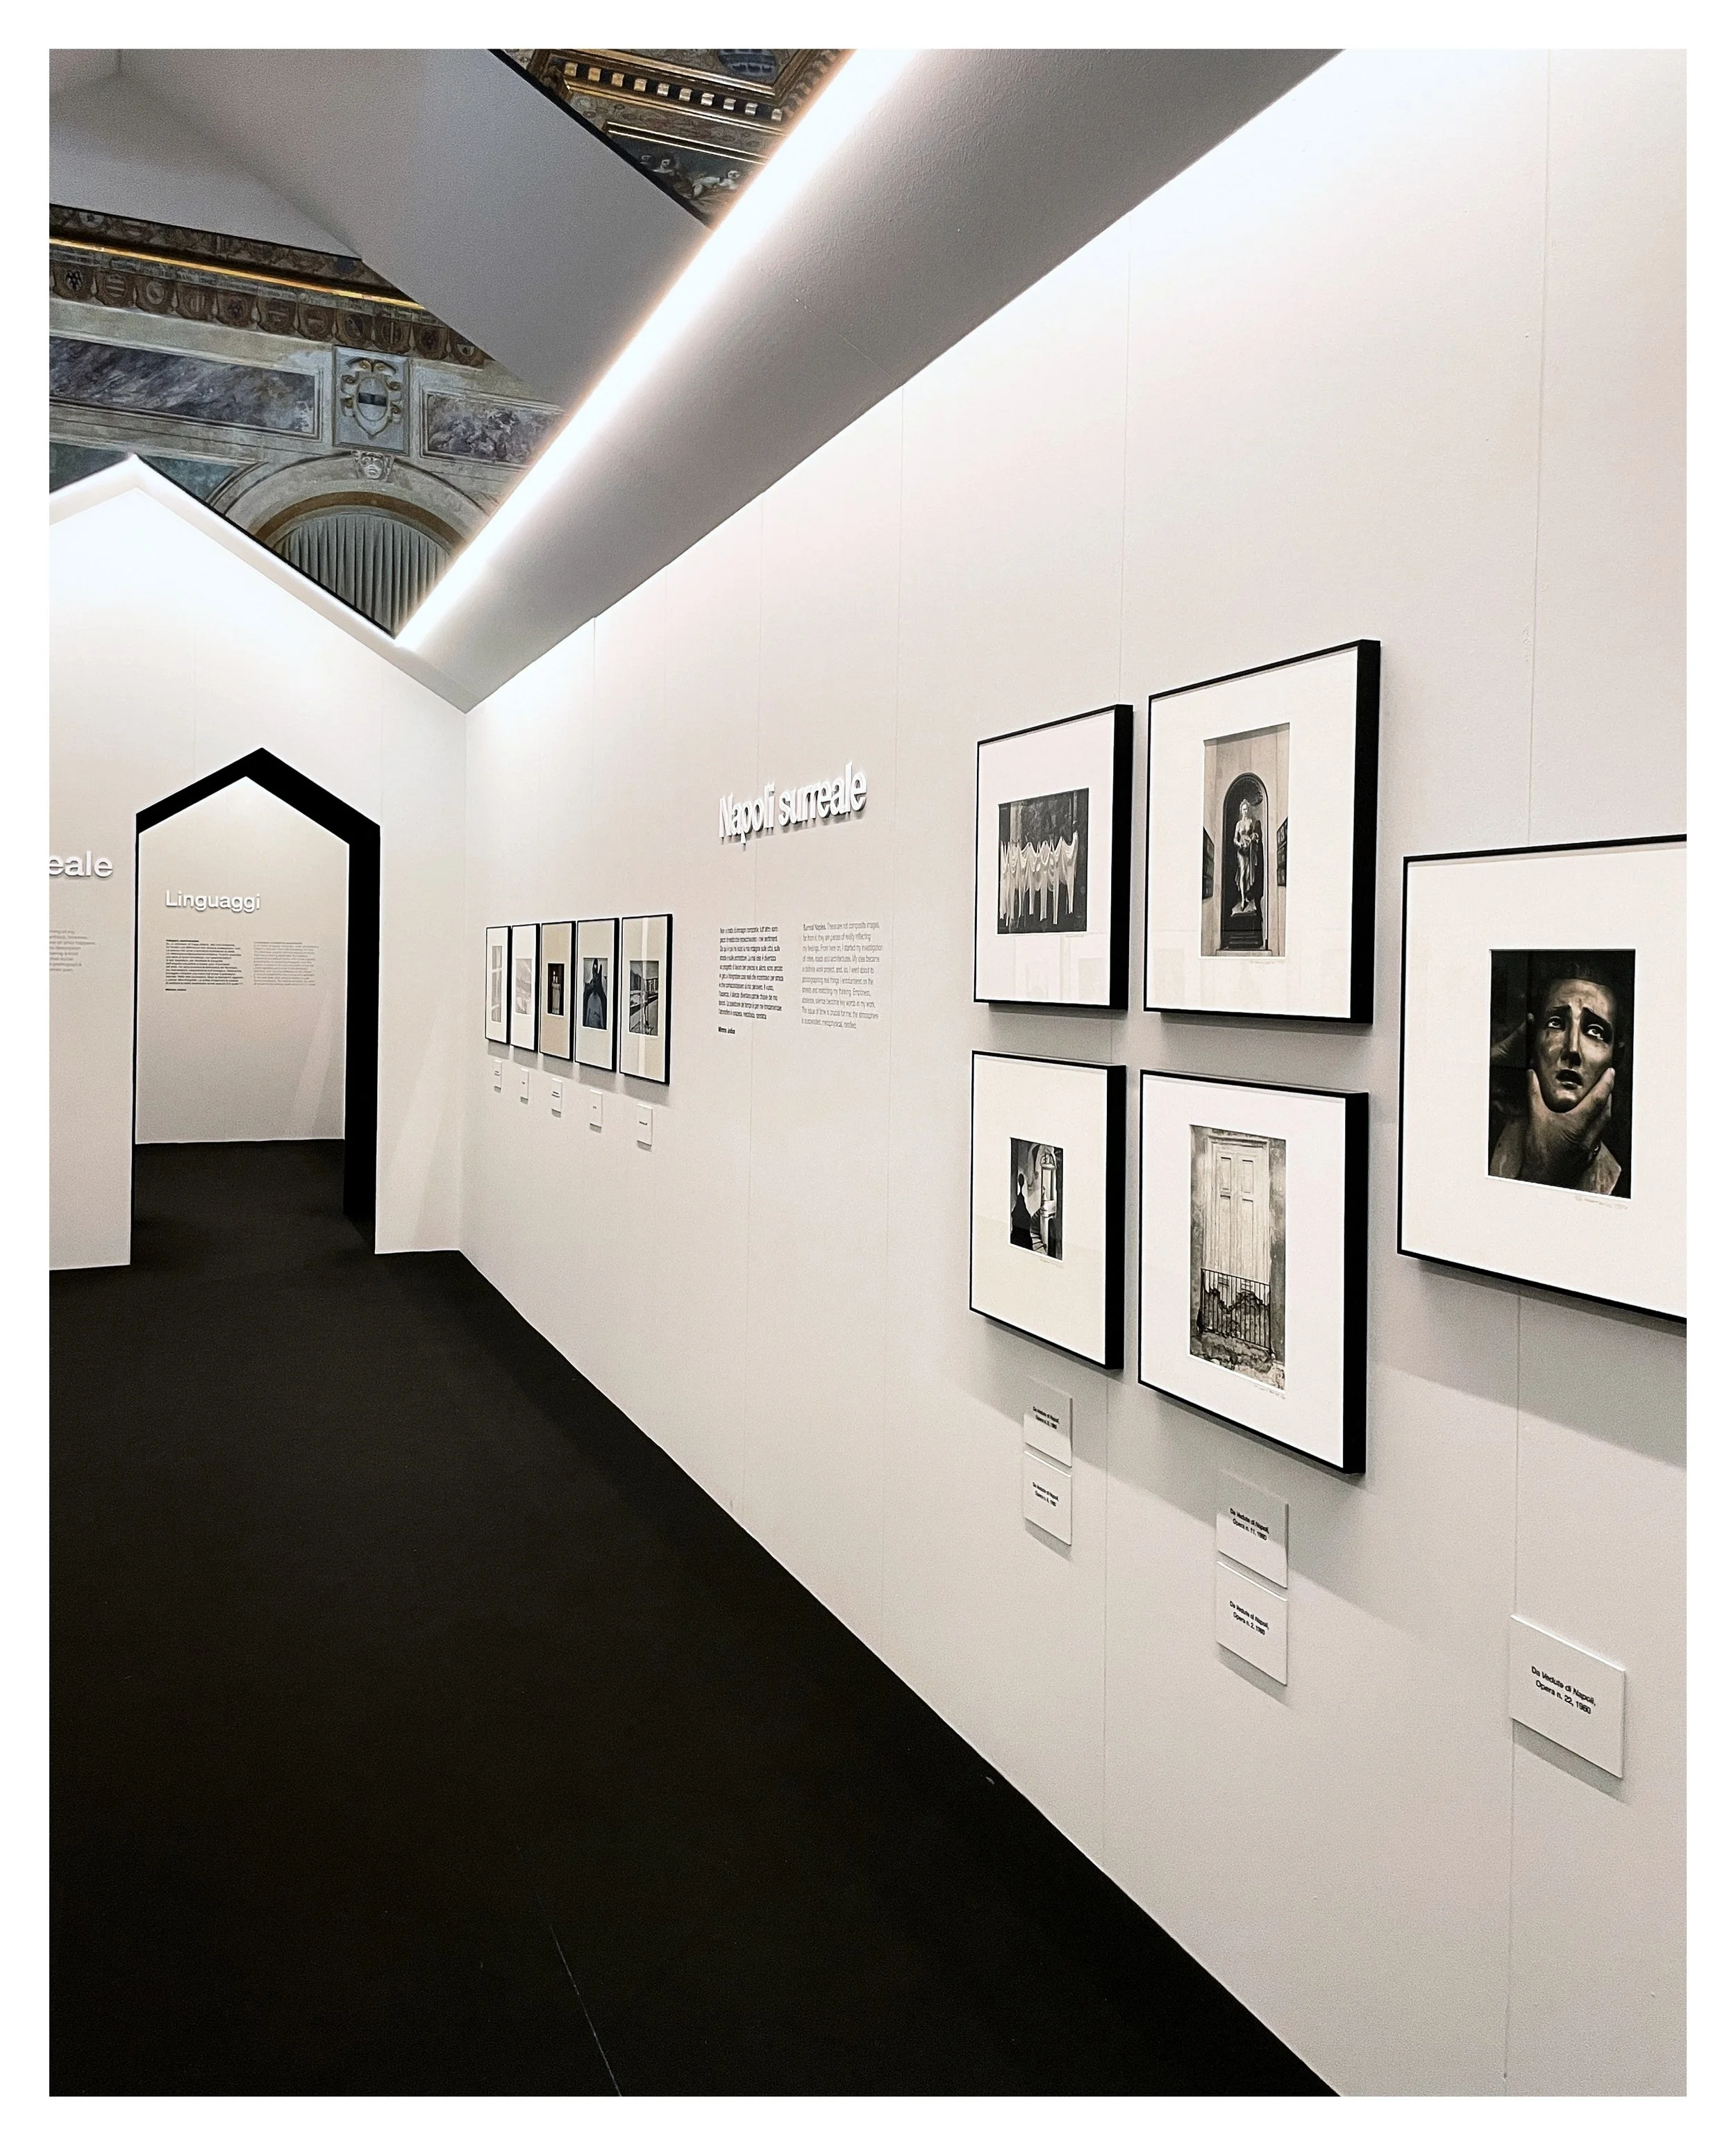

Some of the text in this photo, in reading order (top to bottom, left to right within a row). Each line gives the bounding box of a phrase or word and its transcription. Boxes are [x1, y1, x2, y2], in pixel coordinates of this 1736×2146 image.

[719, 762, 867, 844] Napoli surreale
[49, 850, 113, 877] eale
[165, 890, 261, 913] Linguaggi
[1233, 1612, 1245, 1623] Opera
[1532, 1666, 1540, 1677] Da
[1542, 1672, 1564, 1688] Vedute
[1574, 1688, 1596, 1706] Napoli,
[1536, 1680, 1555, 1695] Opera
[1564, 1695, 1574, 1706] 22,
